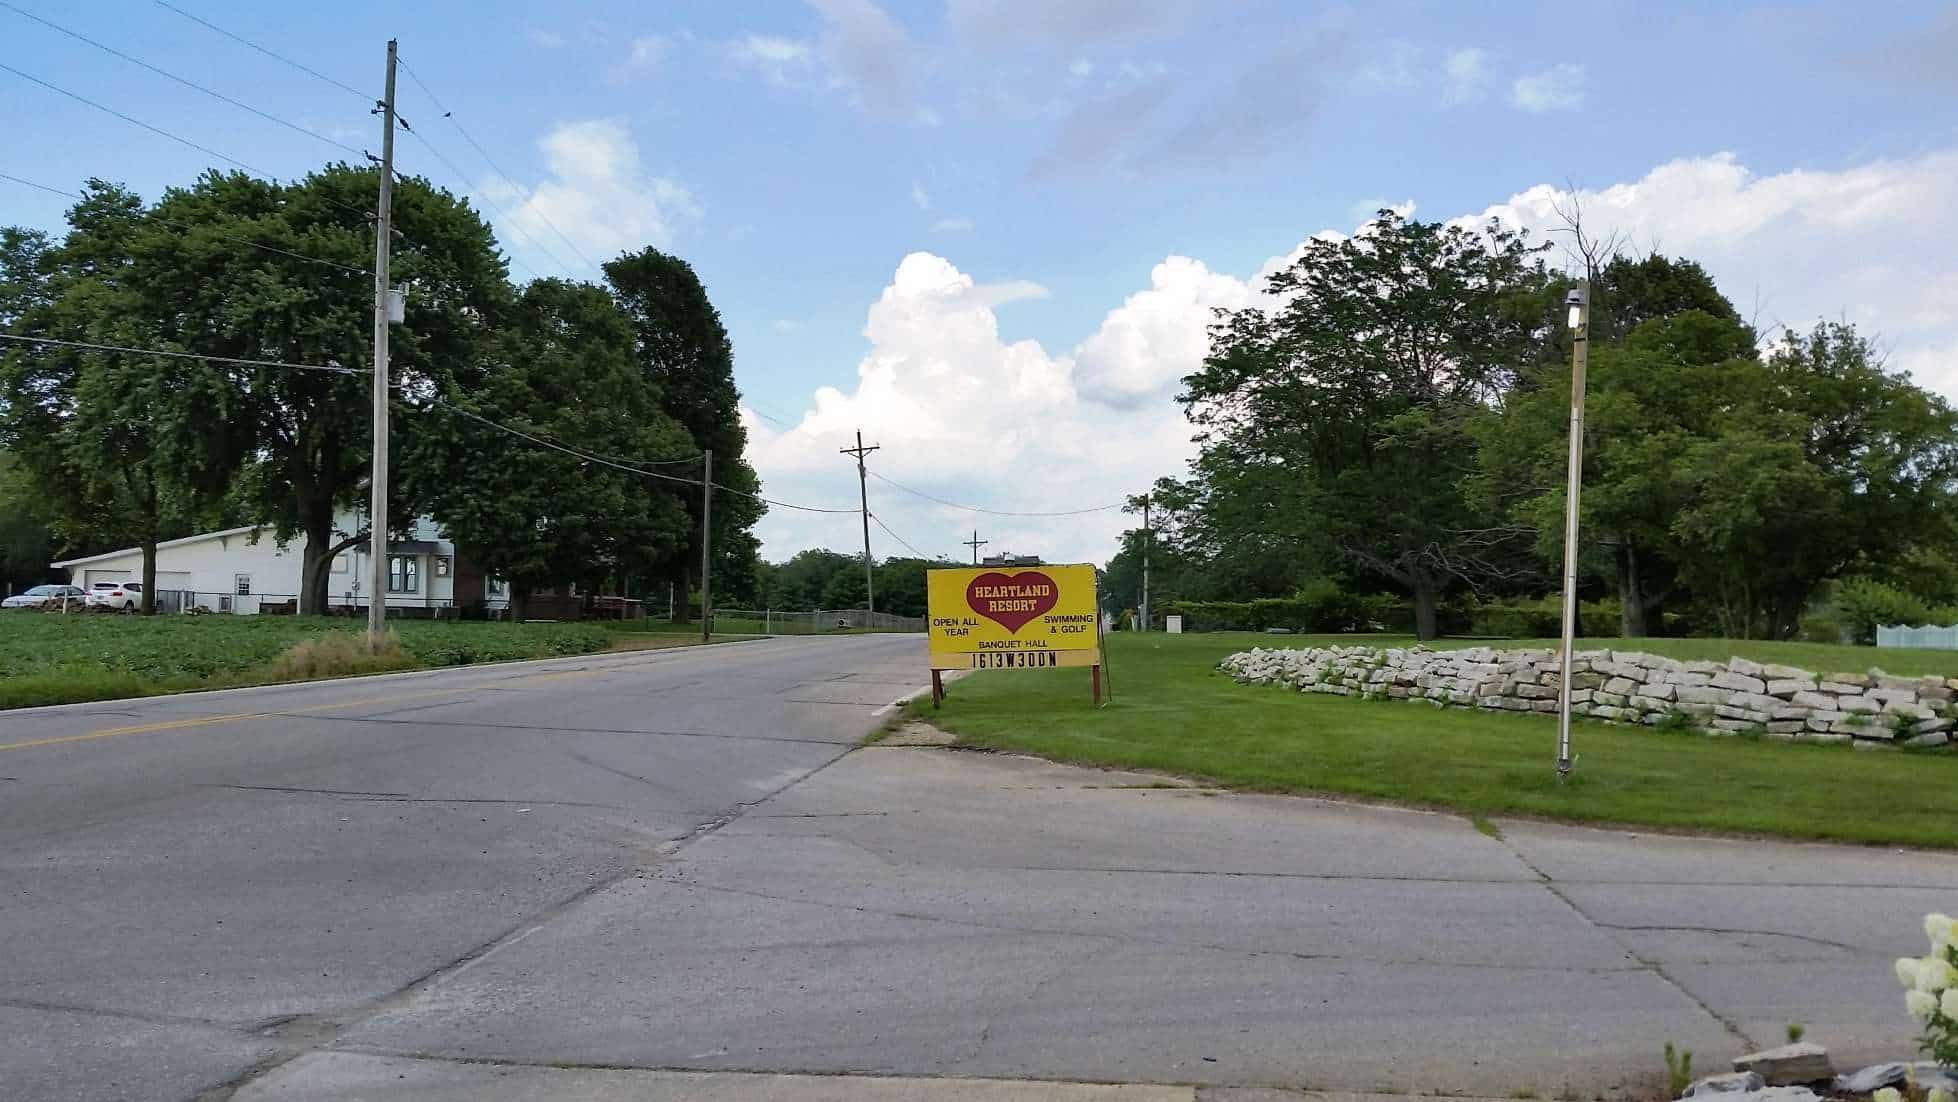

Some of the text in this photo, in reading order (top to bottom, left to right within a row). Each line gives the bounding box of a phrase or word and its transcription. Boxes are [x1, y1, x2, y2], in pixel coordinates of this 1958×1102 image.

[975, 584, 1050, 598] HEARTLAND
[989, 600, 1038, 612] RESORT
[933, 617, 979, 627] OPEN ALL
[1044, 614, 1094, 623] SWIMMING
[944, 628, 969, 636] YEAR
[1050, 625, 1087, 634] & GOLF
[979, 639, 1048, 649] BANQUET HALL
